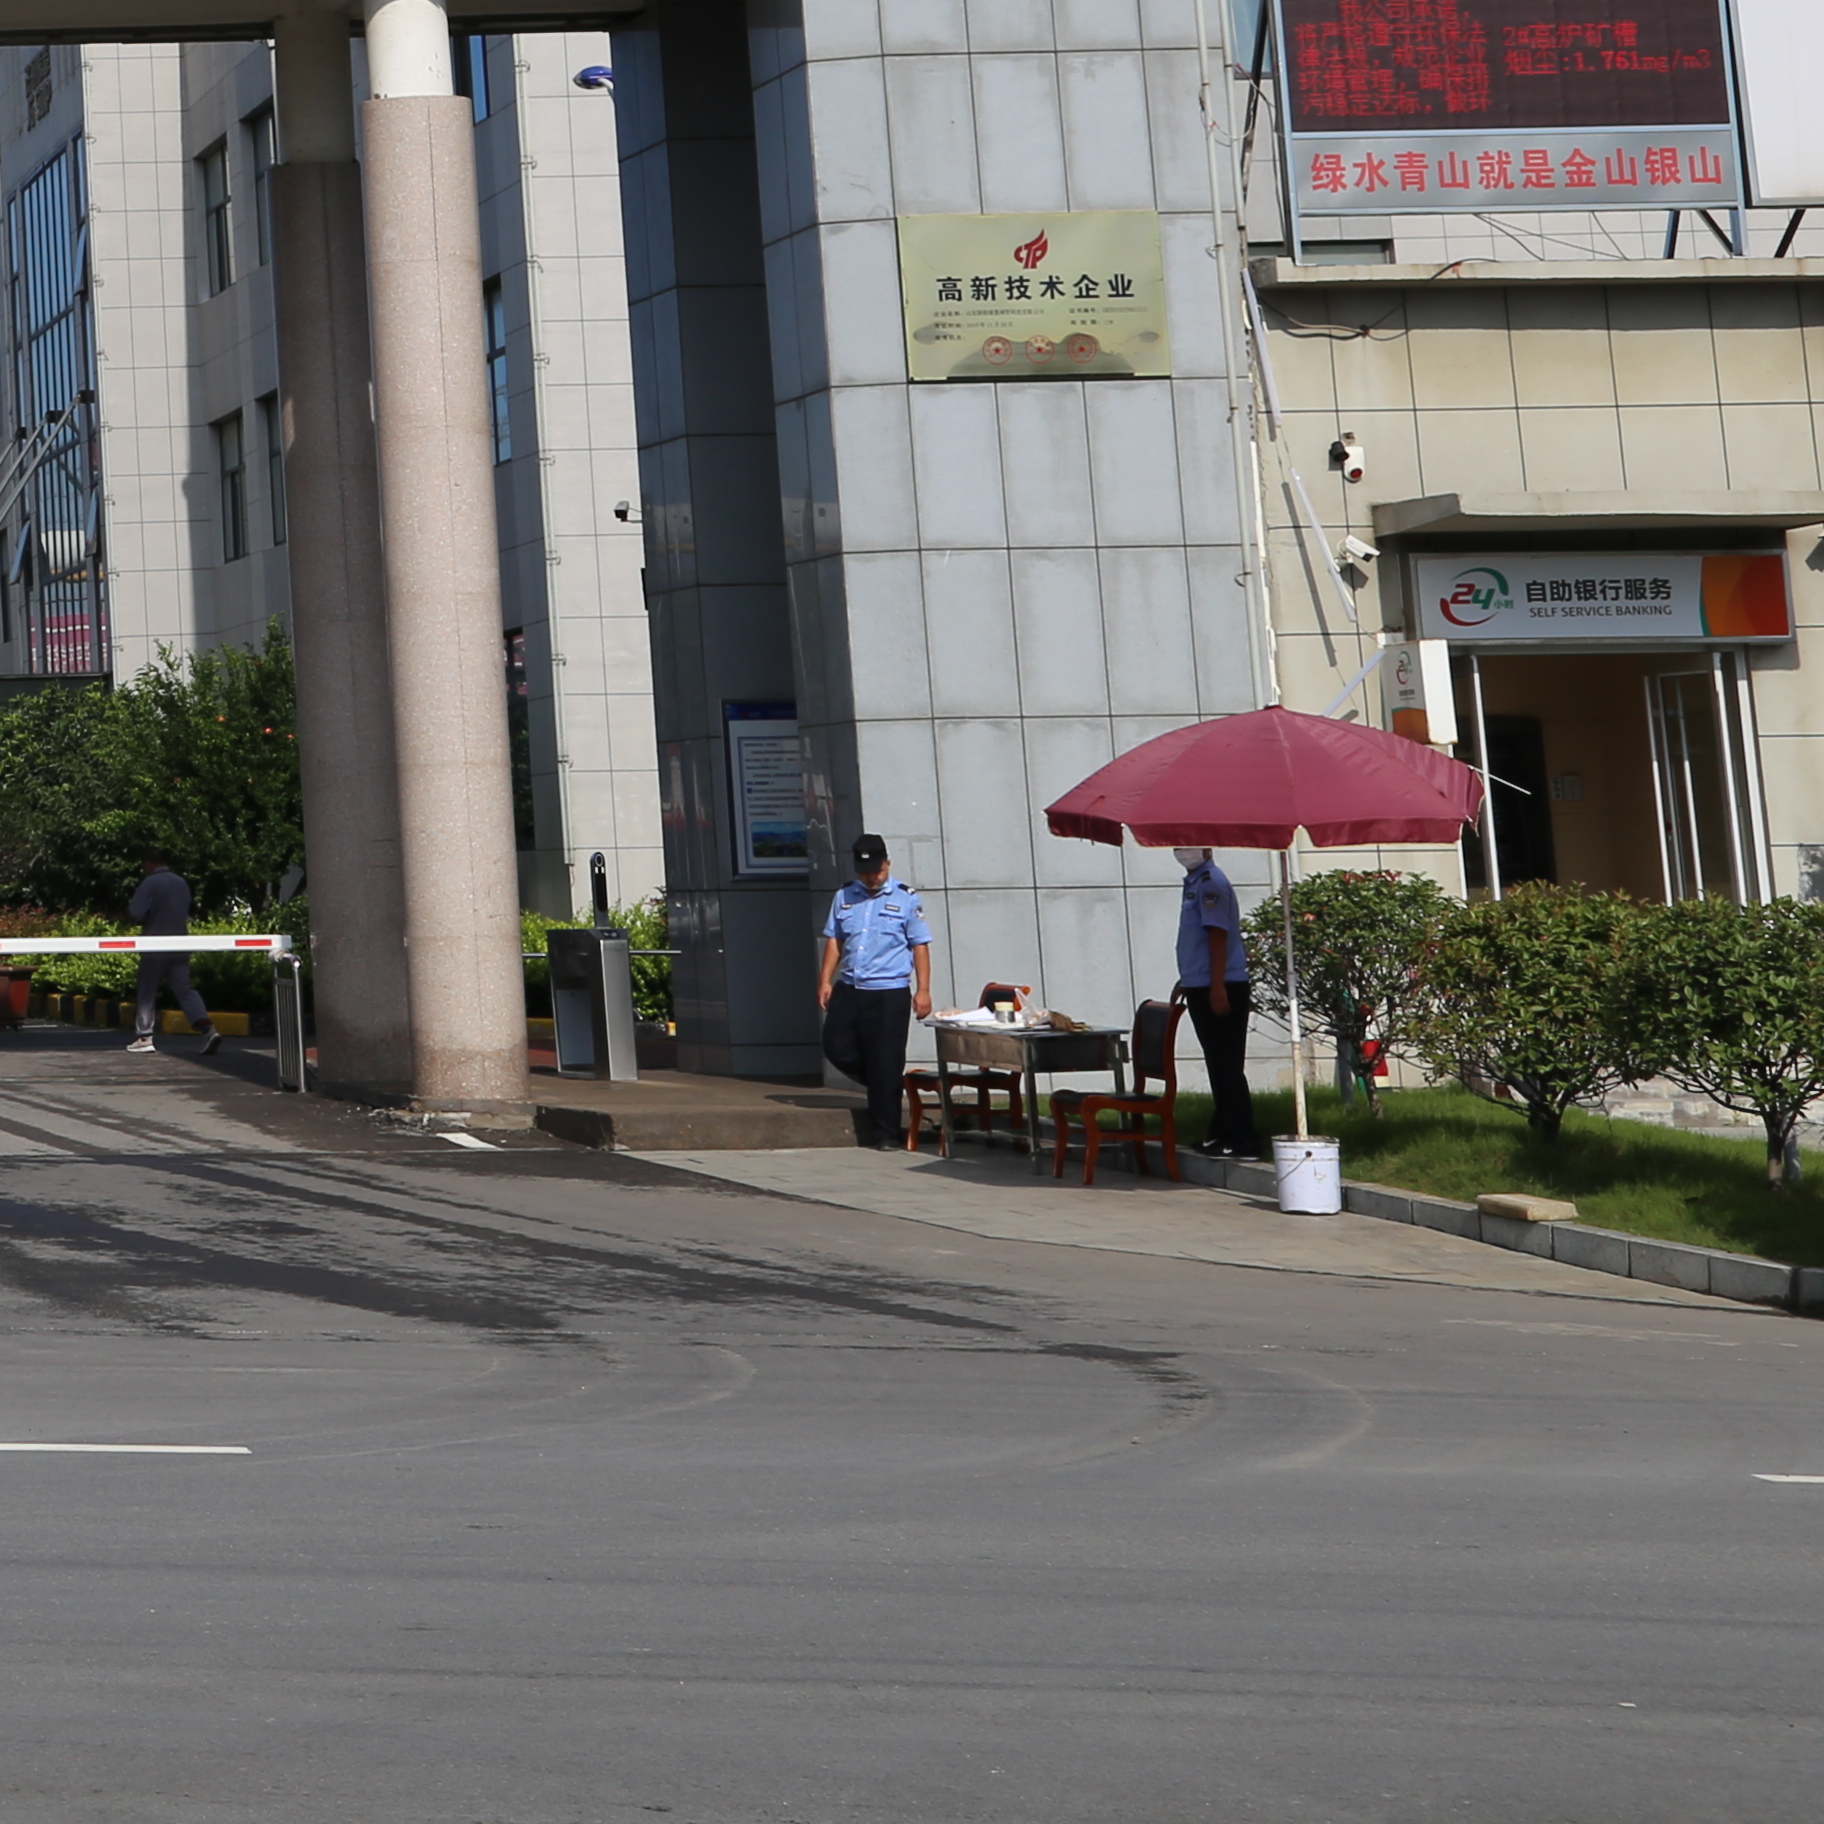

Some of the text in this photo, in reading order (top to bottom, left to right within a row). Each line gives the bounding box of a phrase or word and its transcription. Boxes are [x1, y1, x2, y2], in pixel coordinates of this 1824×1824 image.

[1309, 146, 1724, 196] 绿水青山就是金山银山
[935, 274, 1135, 303] 高新技术企业
[1525, 577, 1673, 604] 自助银行服务
[1529, 604, 1673, 618] SELF SERVICE BANKING
